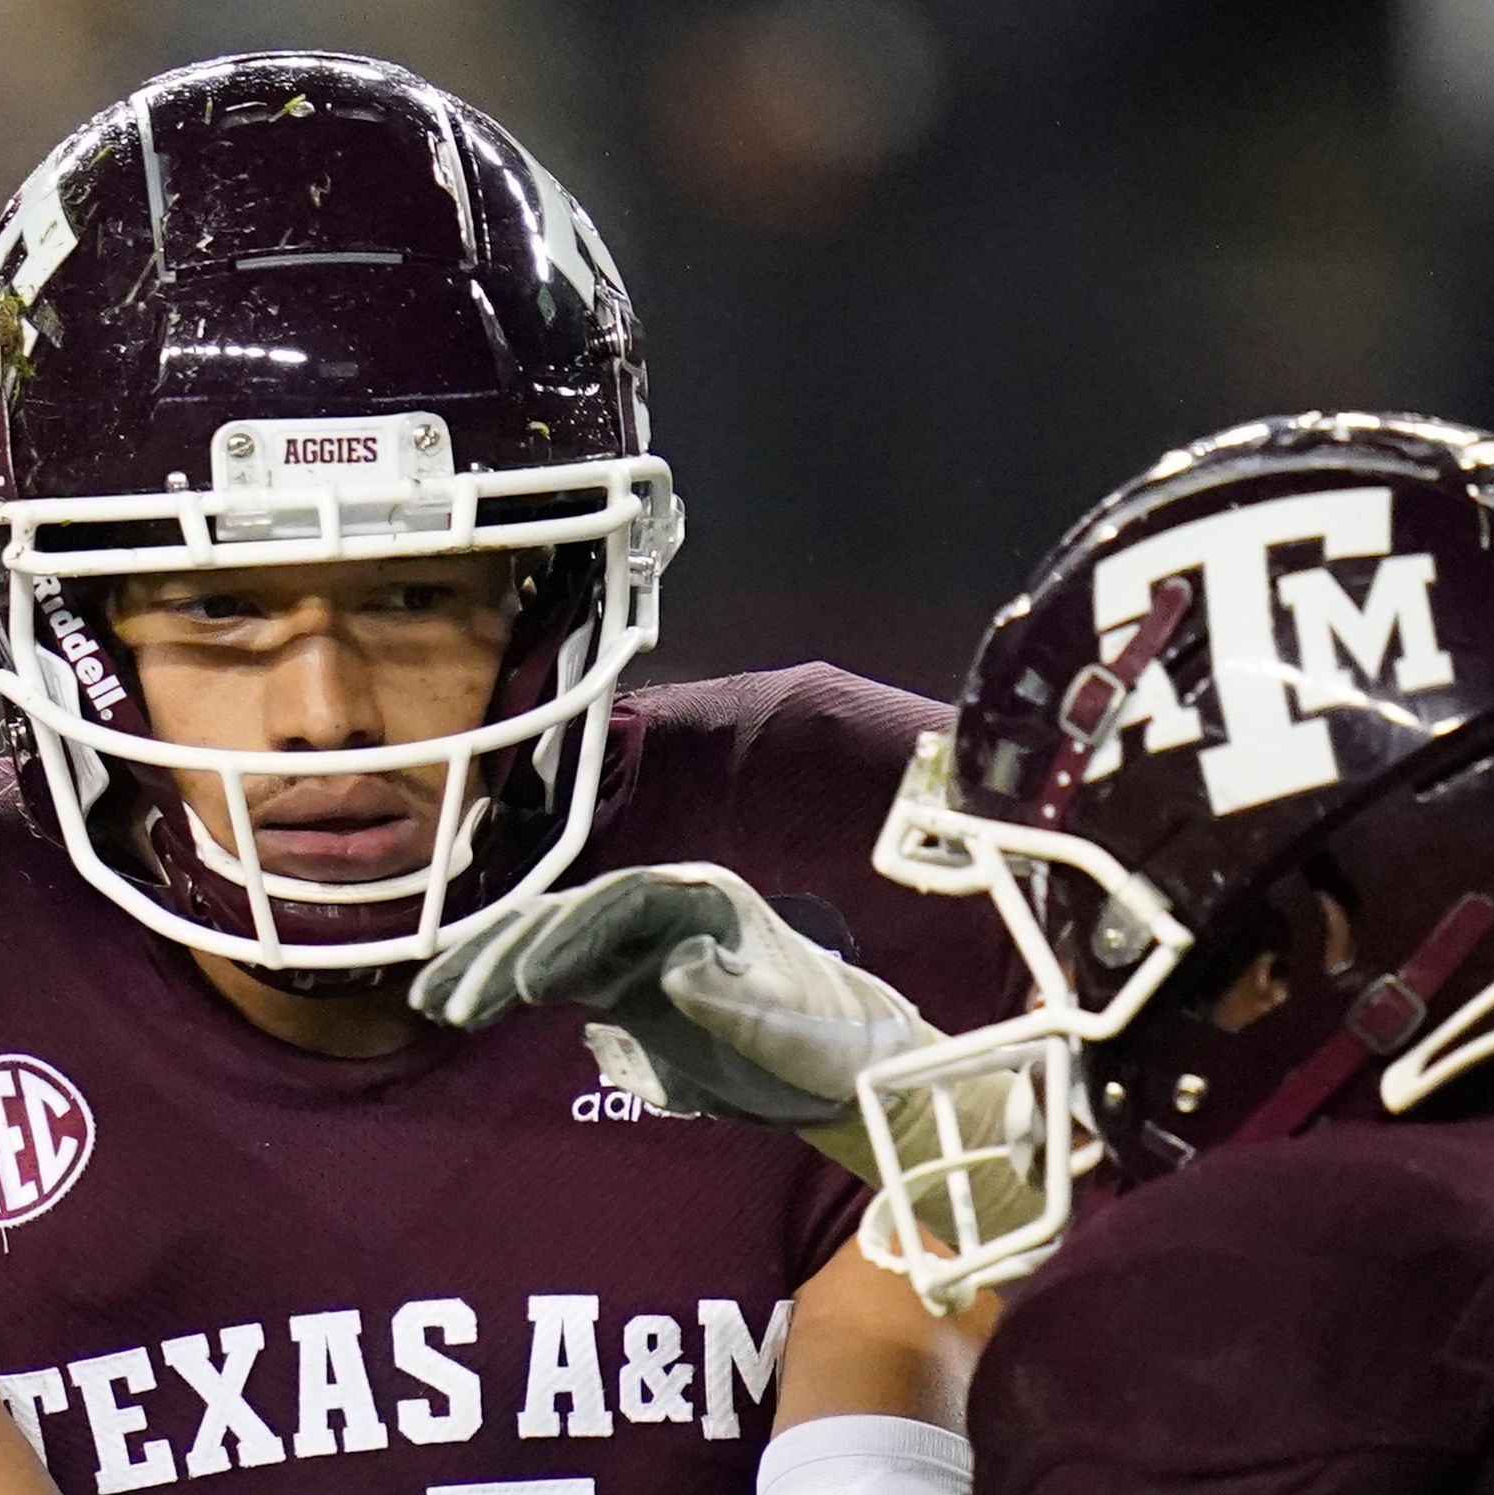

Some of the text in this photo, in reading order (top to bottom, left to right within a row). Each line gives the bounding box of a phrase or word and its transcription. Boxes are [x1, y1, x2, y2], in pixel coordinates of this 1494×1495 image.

[283, 437, 378, 465] AGGIES
[33, 573, 128, 712] Riddell
[517, 1293, 796, 1441] A&M
